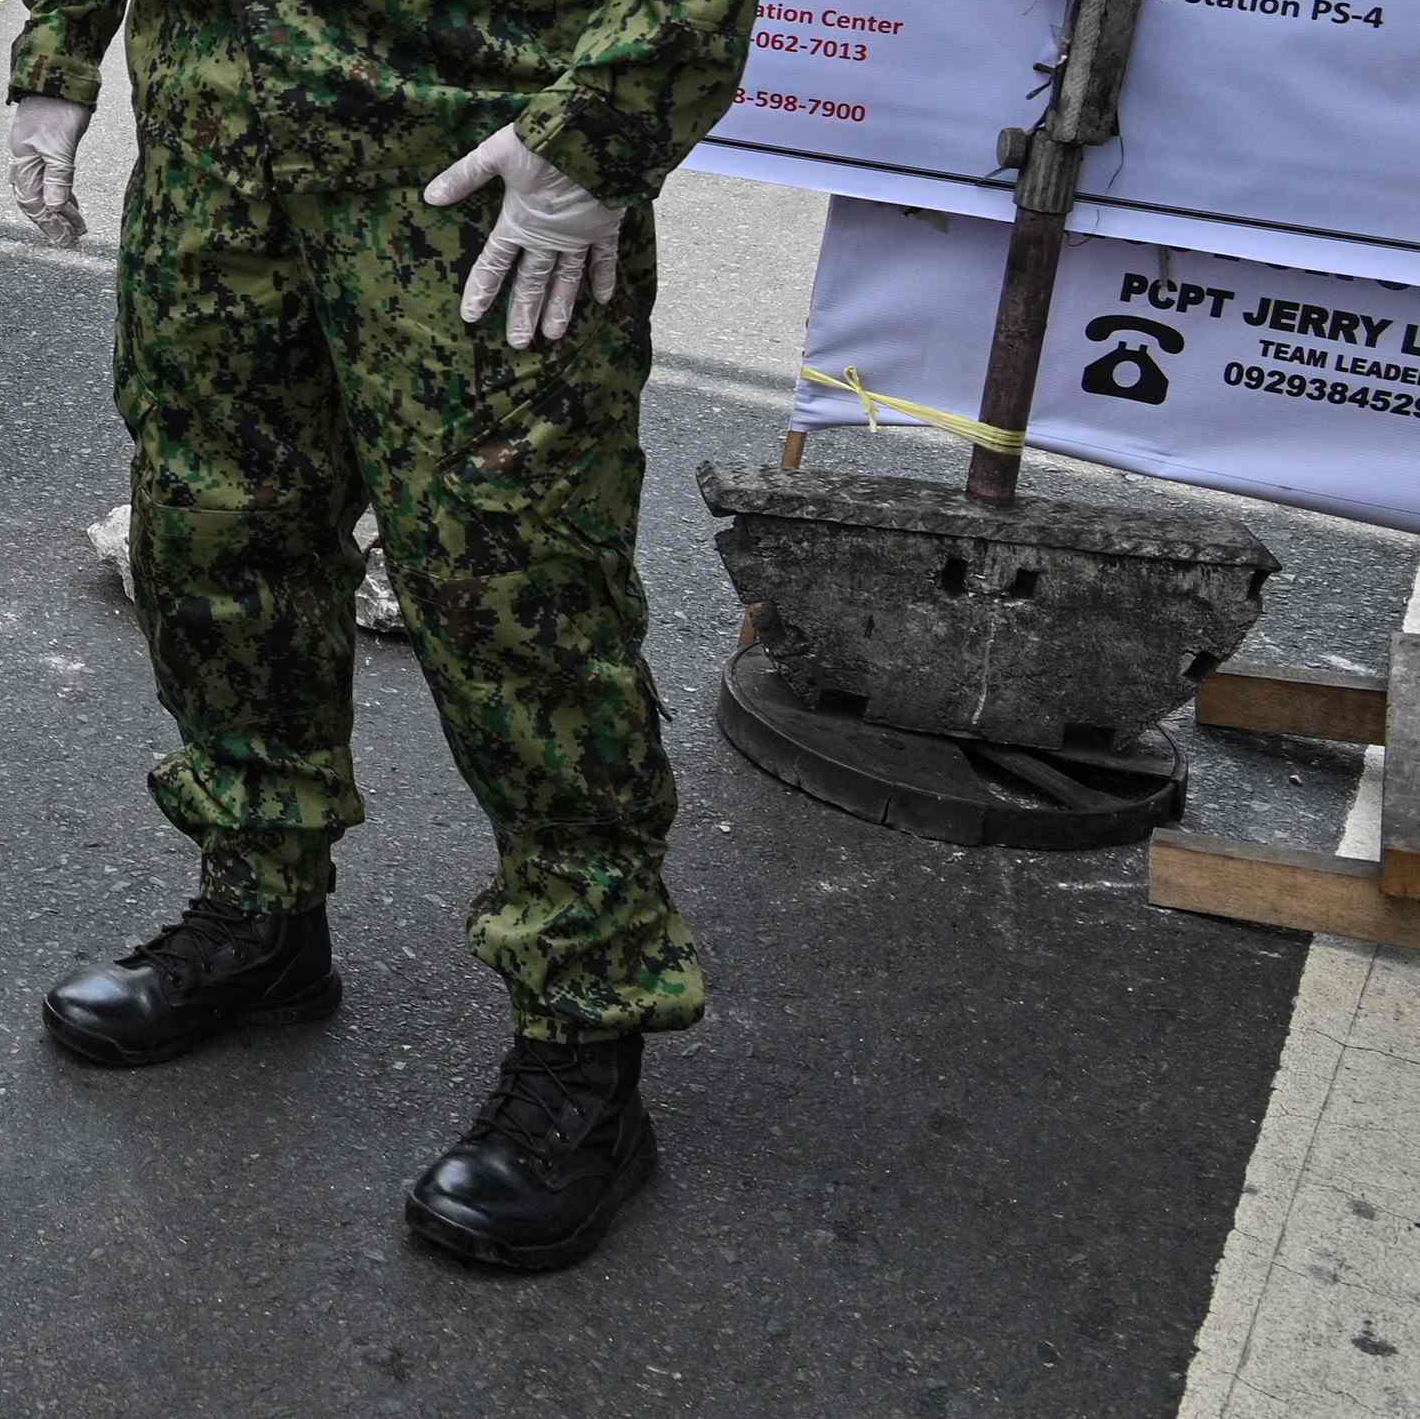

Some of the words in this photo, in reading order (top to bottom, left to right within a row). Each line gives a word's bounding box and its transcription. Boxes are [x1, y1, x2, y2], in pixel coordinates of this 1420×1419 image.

[821, 9, 904, 36] Center
[750, 31, 868, 62] -062-7013
[1119, 272, 1235, 318] PCPT
[1242, 297, 1394, 348] JERRY
[1259, 339, 1328, 368] TEAM
[1335, 354, 1420, 386] LEADE
